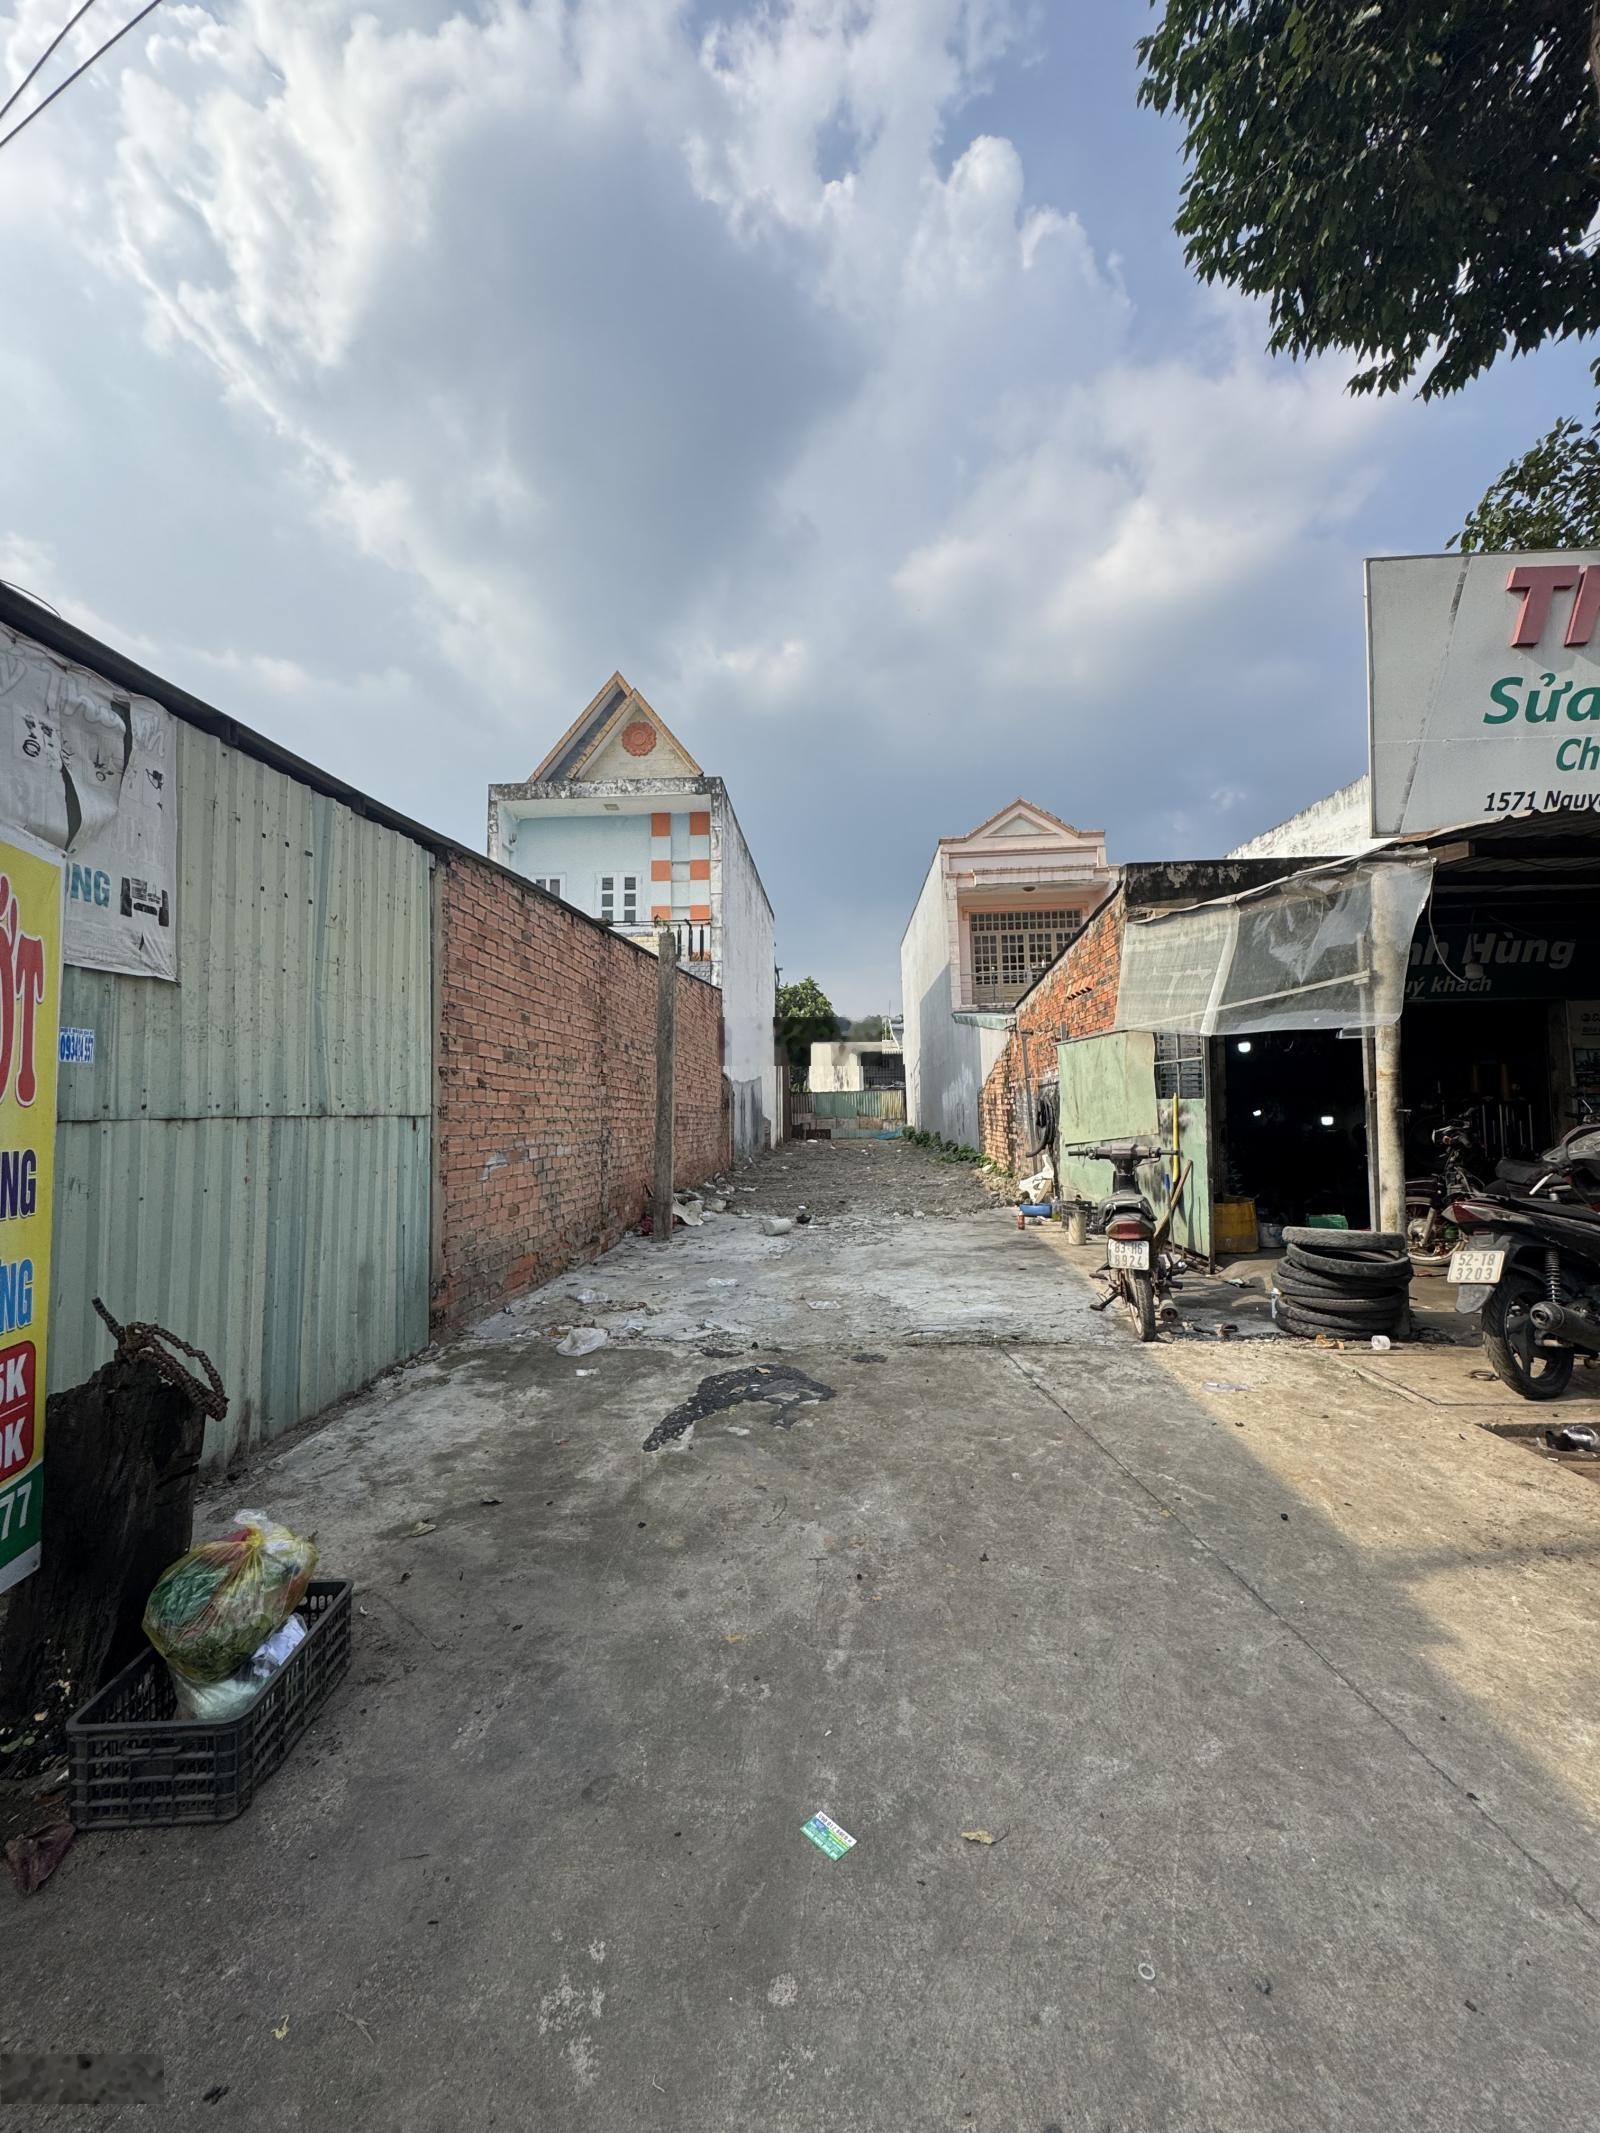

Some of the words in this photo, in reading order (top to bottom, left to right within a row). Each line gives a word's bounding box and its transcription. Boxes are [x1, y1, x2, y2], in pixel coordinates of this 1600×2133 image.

[1483, 672, 1600, 725] Sửa
[1484, 791, 1536, 812] 1571
[1544, 790, 1600, 810] Nguy
[65, 862, 110, 907] NG
[1462, 931, 1576, 970] Hùng
[1455, 1267, 1493, 1280] 3203
[1458, 1253, 1496, 1266] 52-T8
